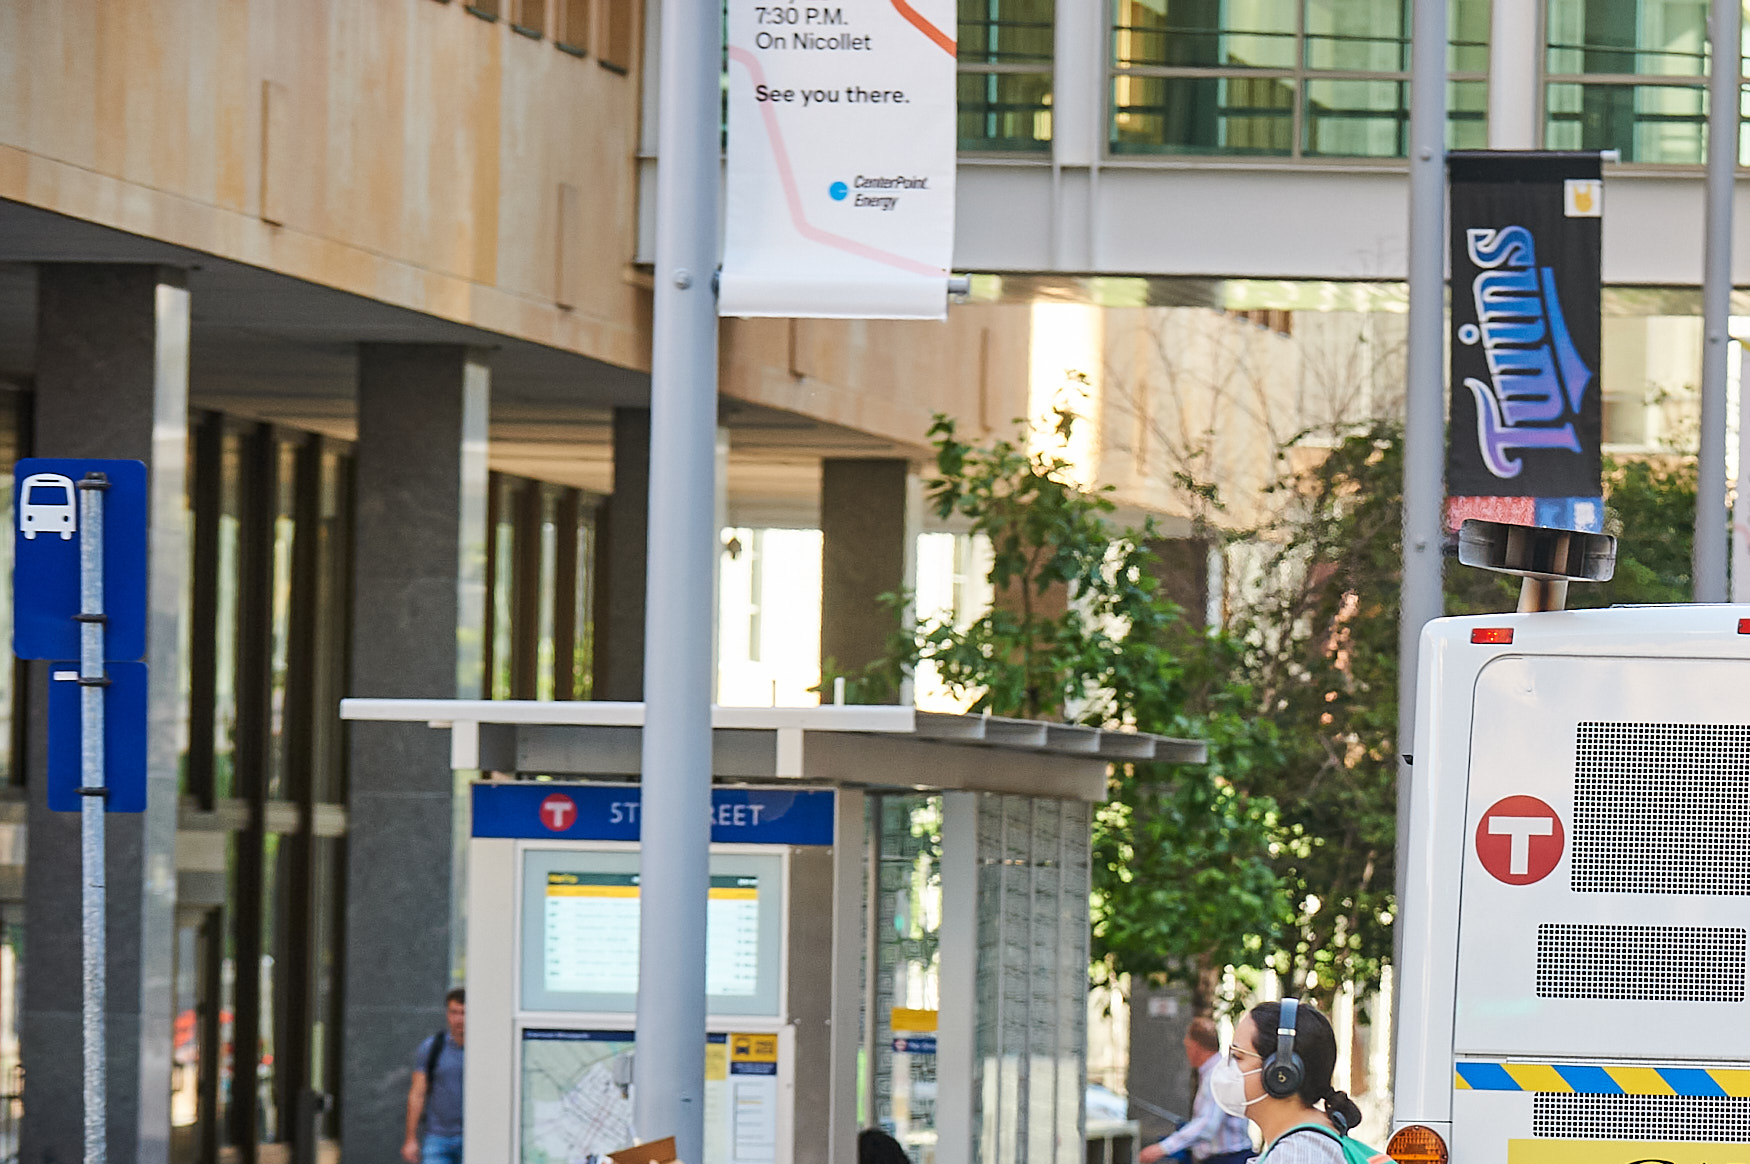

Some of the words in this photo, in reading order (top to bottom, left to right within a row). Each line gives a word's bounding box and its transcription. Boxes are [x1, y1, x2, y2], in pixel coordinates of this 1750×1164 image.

[755, 8, 799, 25] 7:30
[805, 8, 849, 25] P.M.
[756, 32, 787, 50] On
[793, 33, 873, 51] Nicollet
[755, 85, 796, 102] See
[801, 88, 840, 107] you
[846, 87, 911, 103] there.
[854, 175, 930, 189] CenterPoint
[854, 194, 898, 211] Energy
[1458, 225, 1592, 478] Twins
[1488, 816, 1554, 876] T
